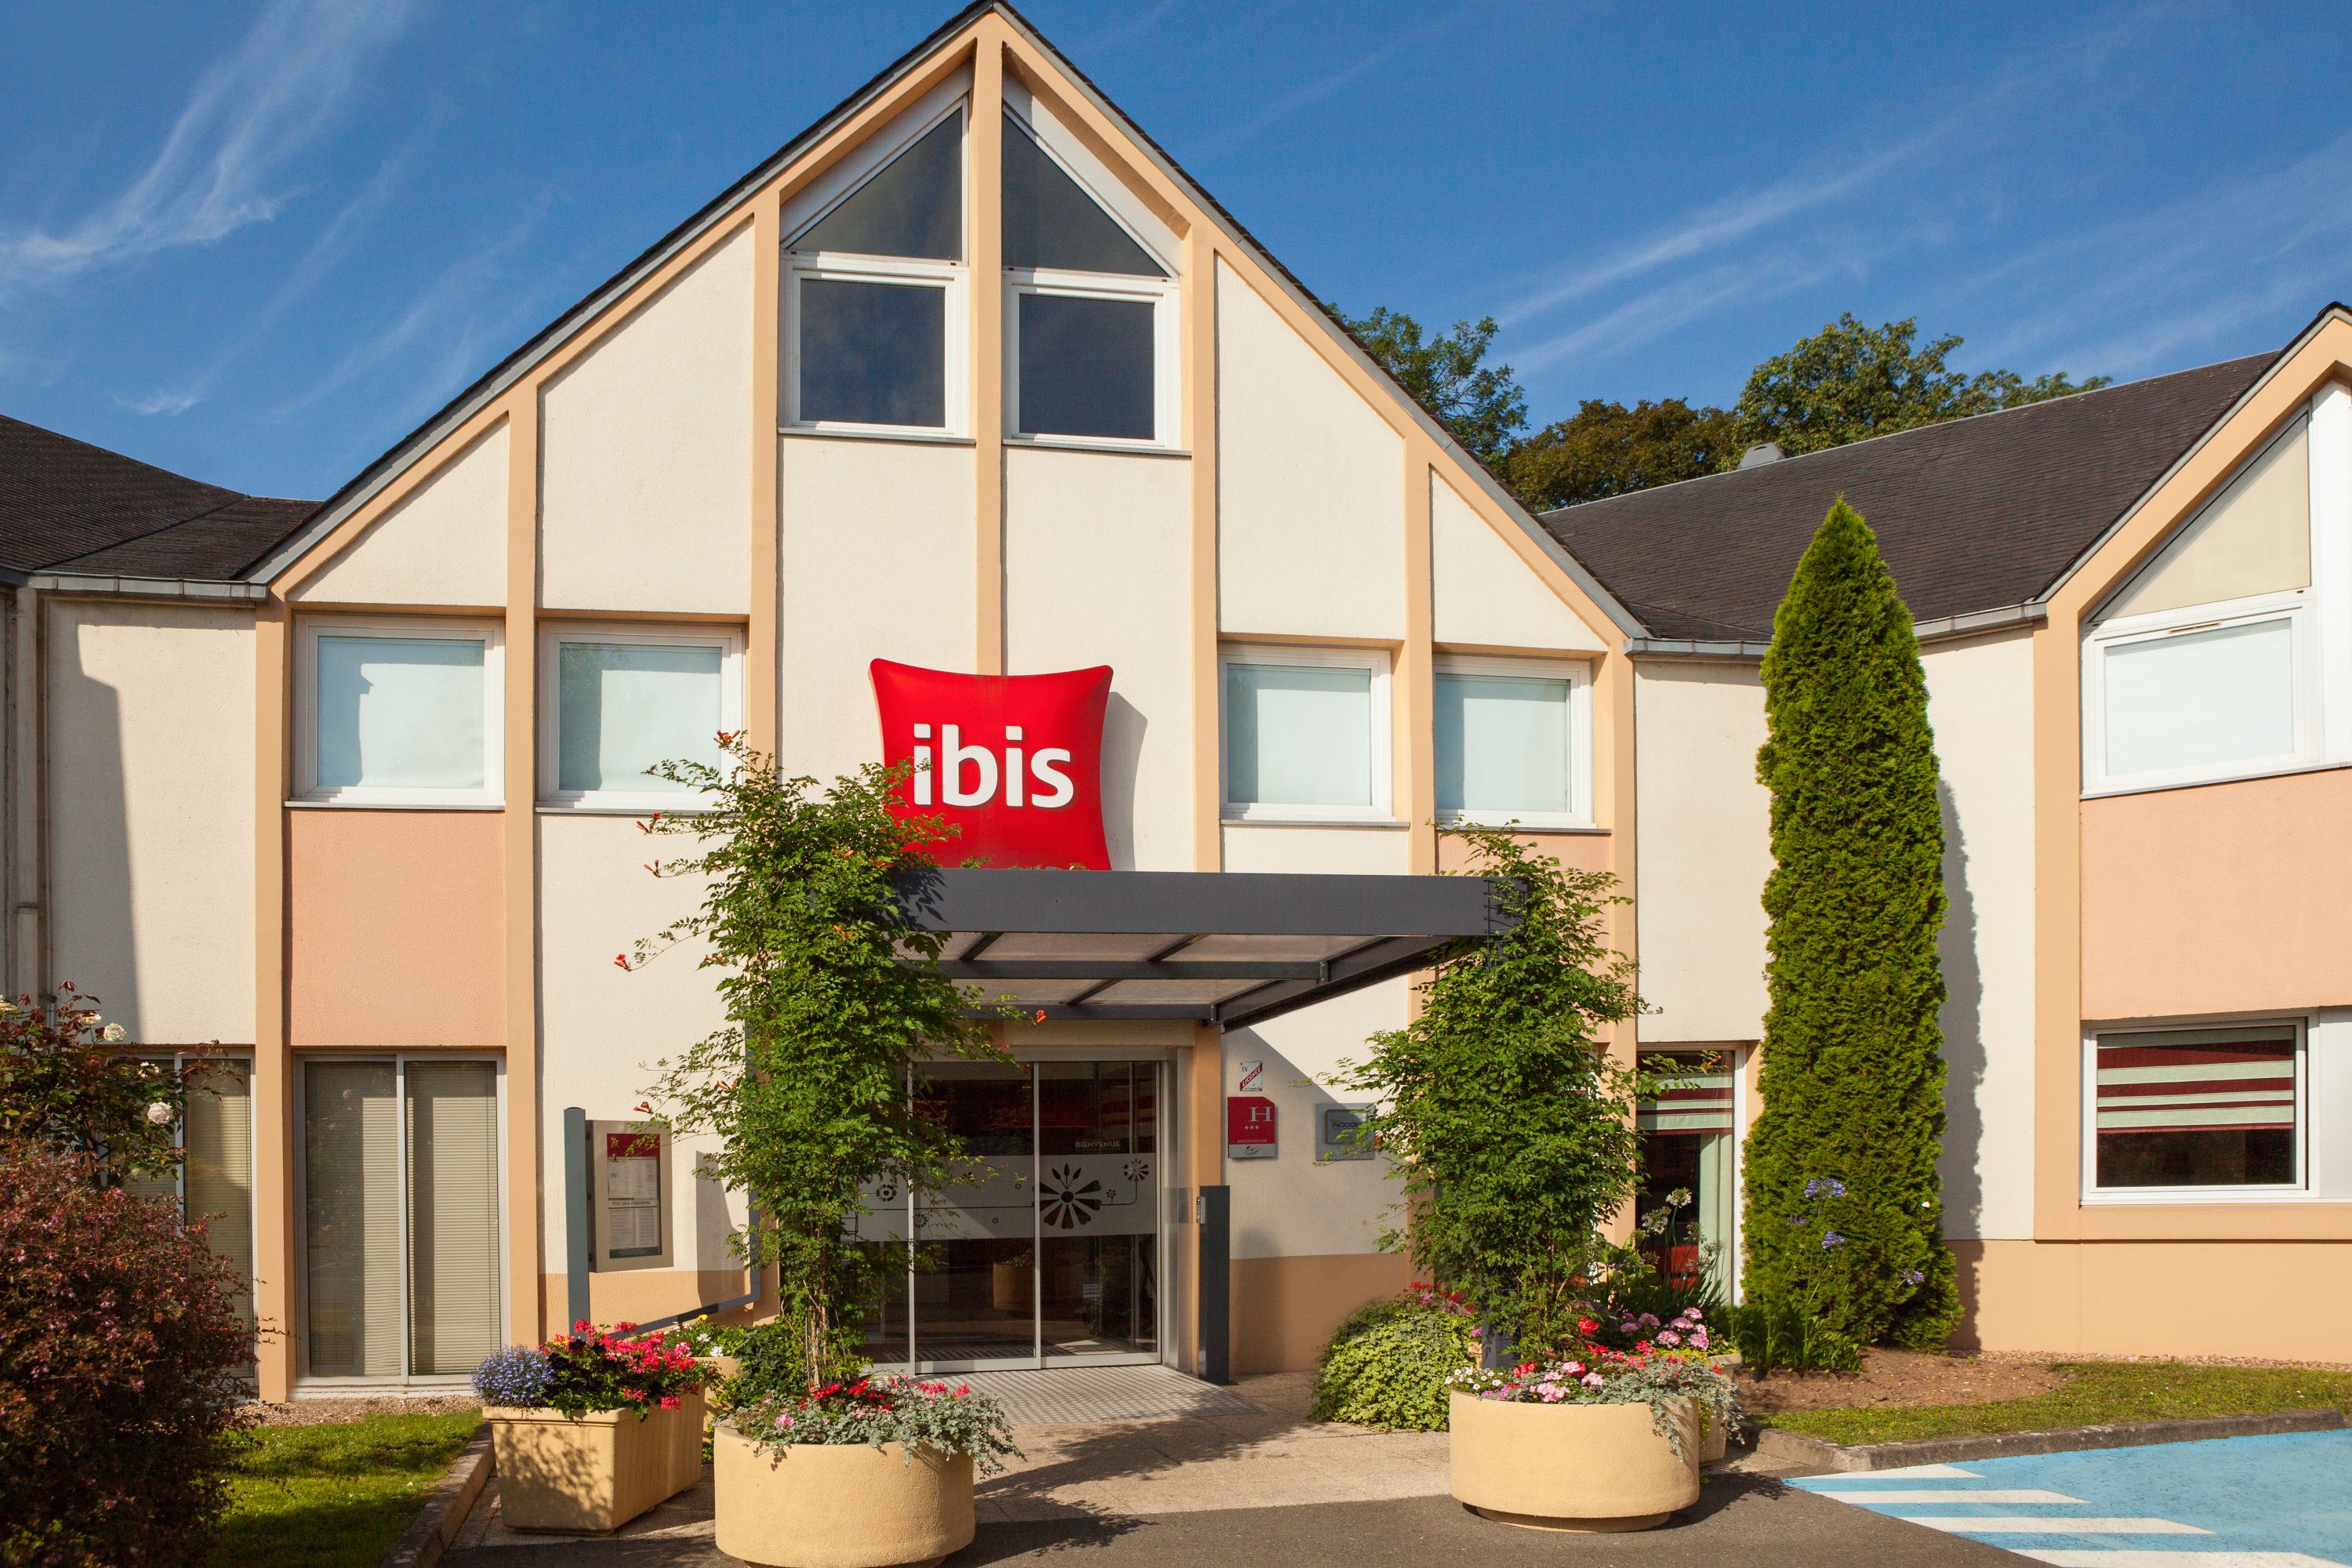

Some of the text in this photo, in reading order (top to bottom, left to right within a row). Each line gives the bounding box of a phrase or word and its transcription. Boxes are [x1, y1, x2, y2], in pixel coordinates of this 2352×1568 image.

[913, 723, 1074, 808] ibis
[1242, 1066, 1261, 1087] LICENCE
[1248, 1106, 1273, 1122] H
